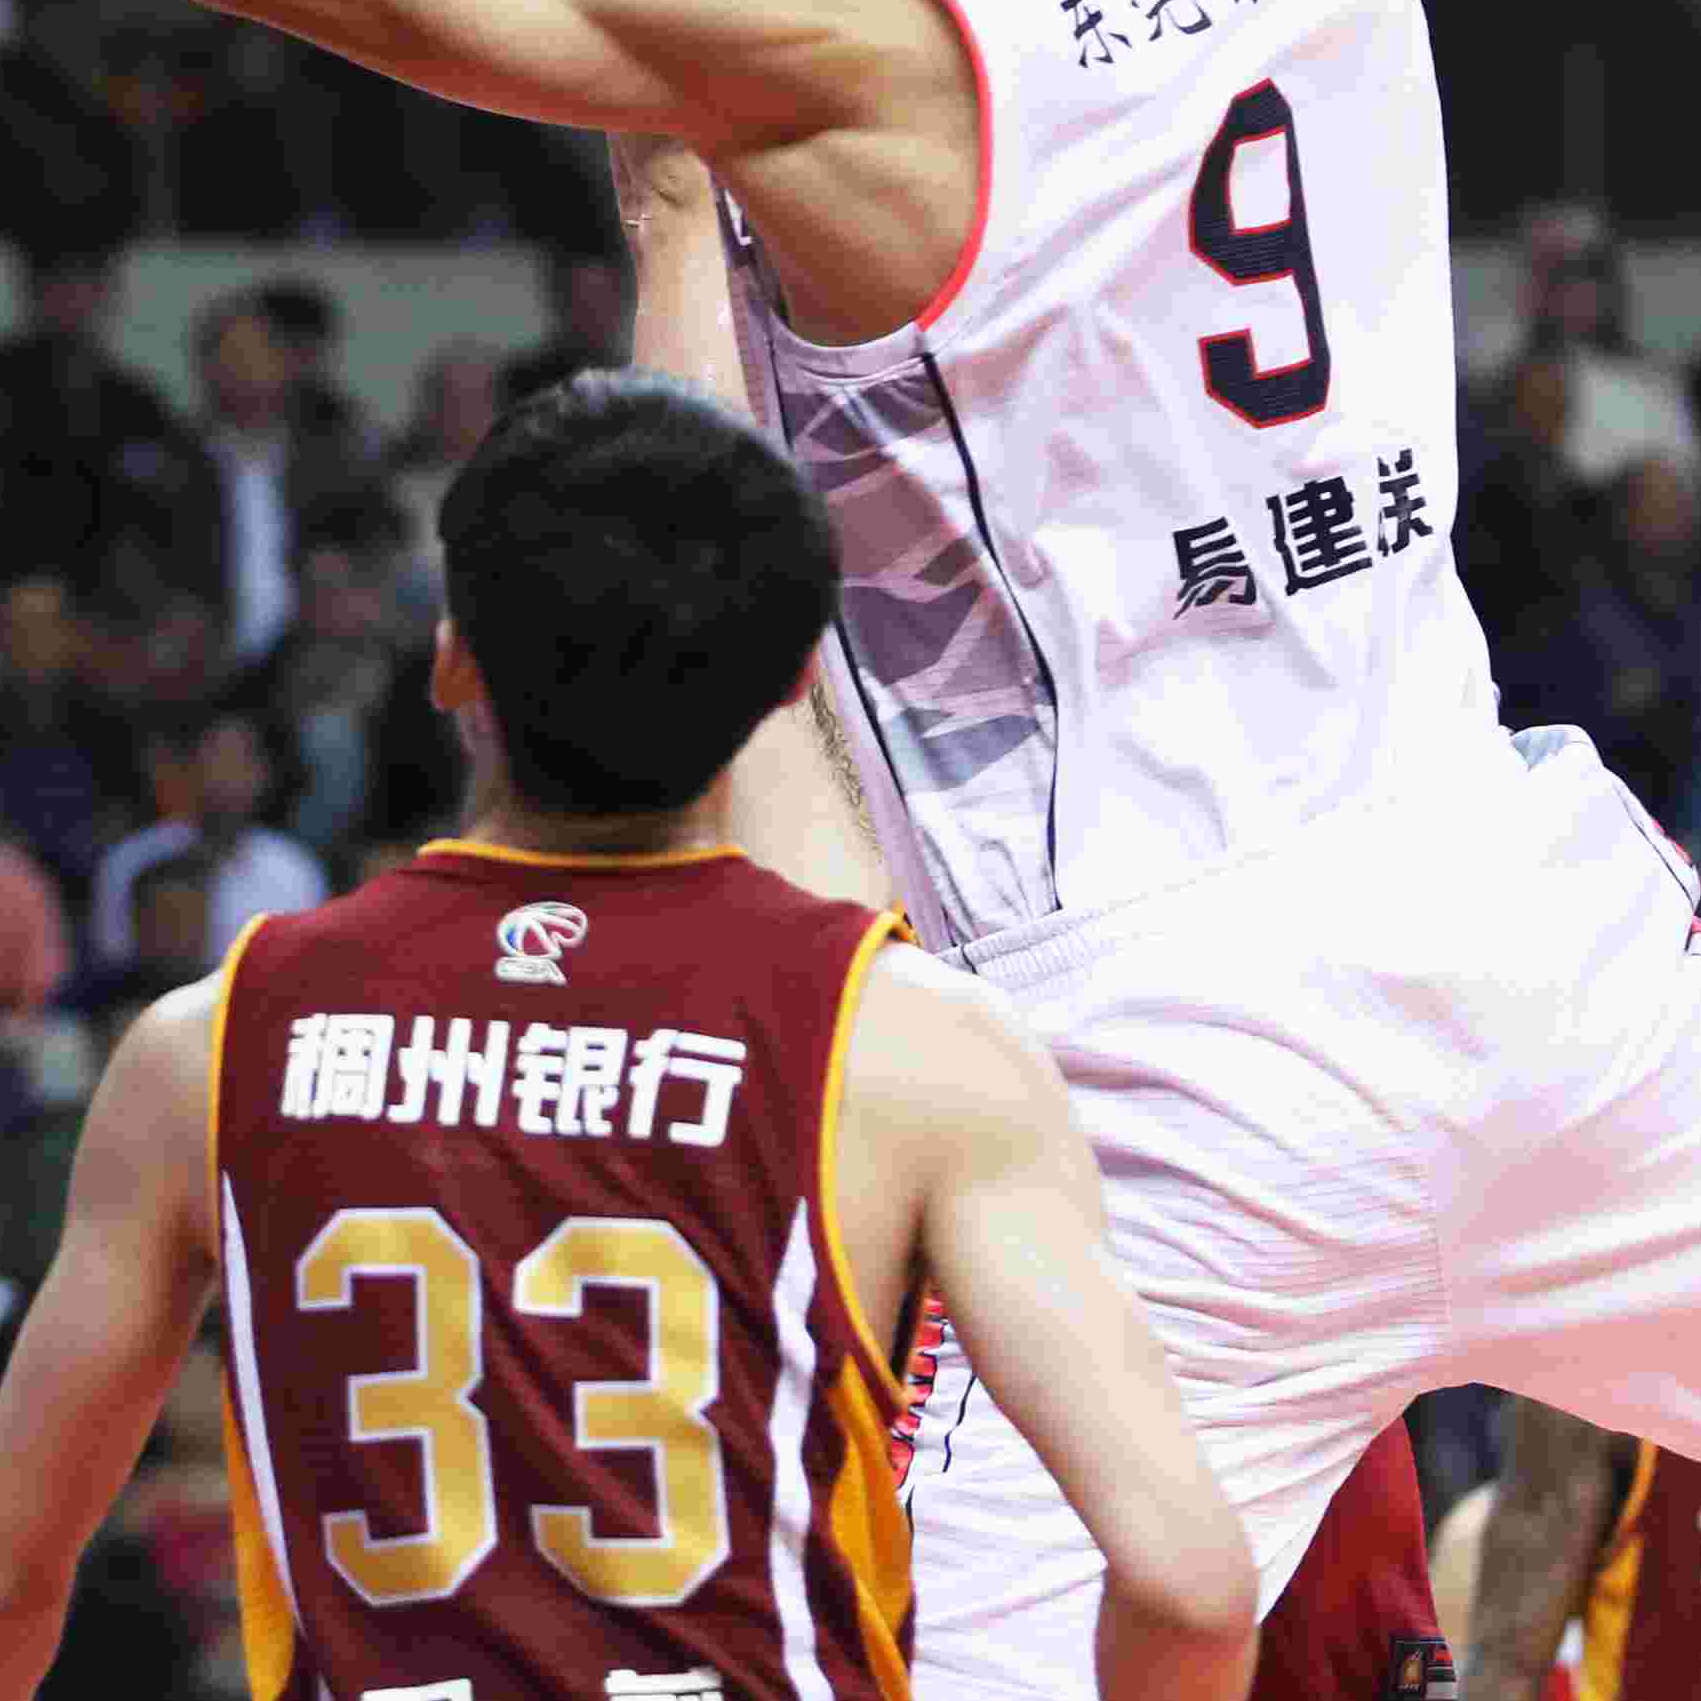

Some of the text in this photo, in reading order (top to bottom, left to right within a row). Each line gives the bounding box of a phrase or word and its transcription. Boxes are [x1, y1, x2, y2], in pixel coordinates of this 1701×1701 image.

[1187, 76, 1331, 429] 9
[279, 1011, 748, 1149] 稠州银行
[295, 1204, 734, 1608] 33
